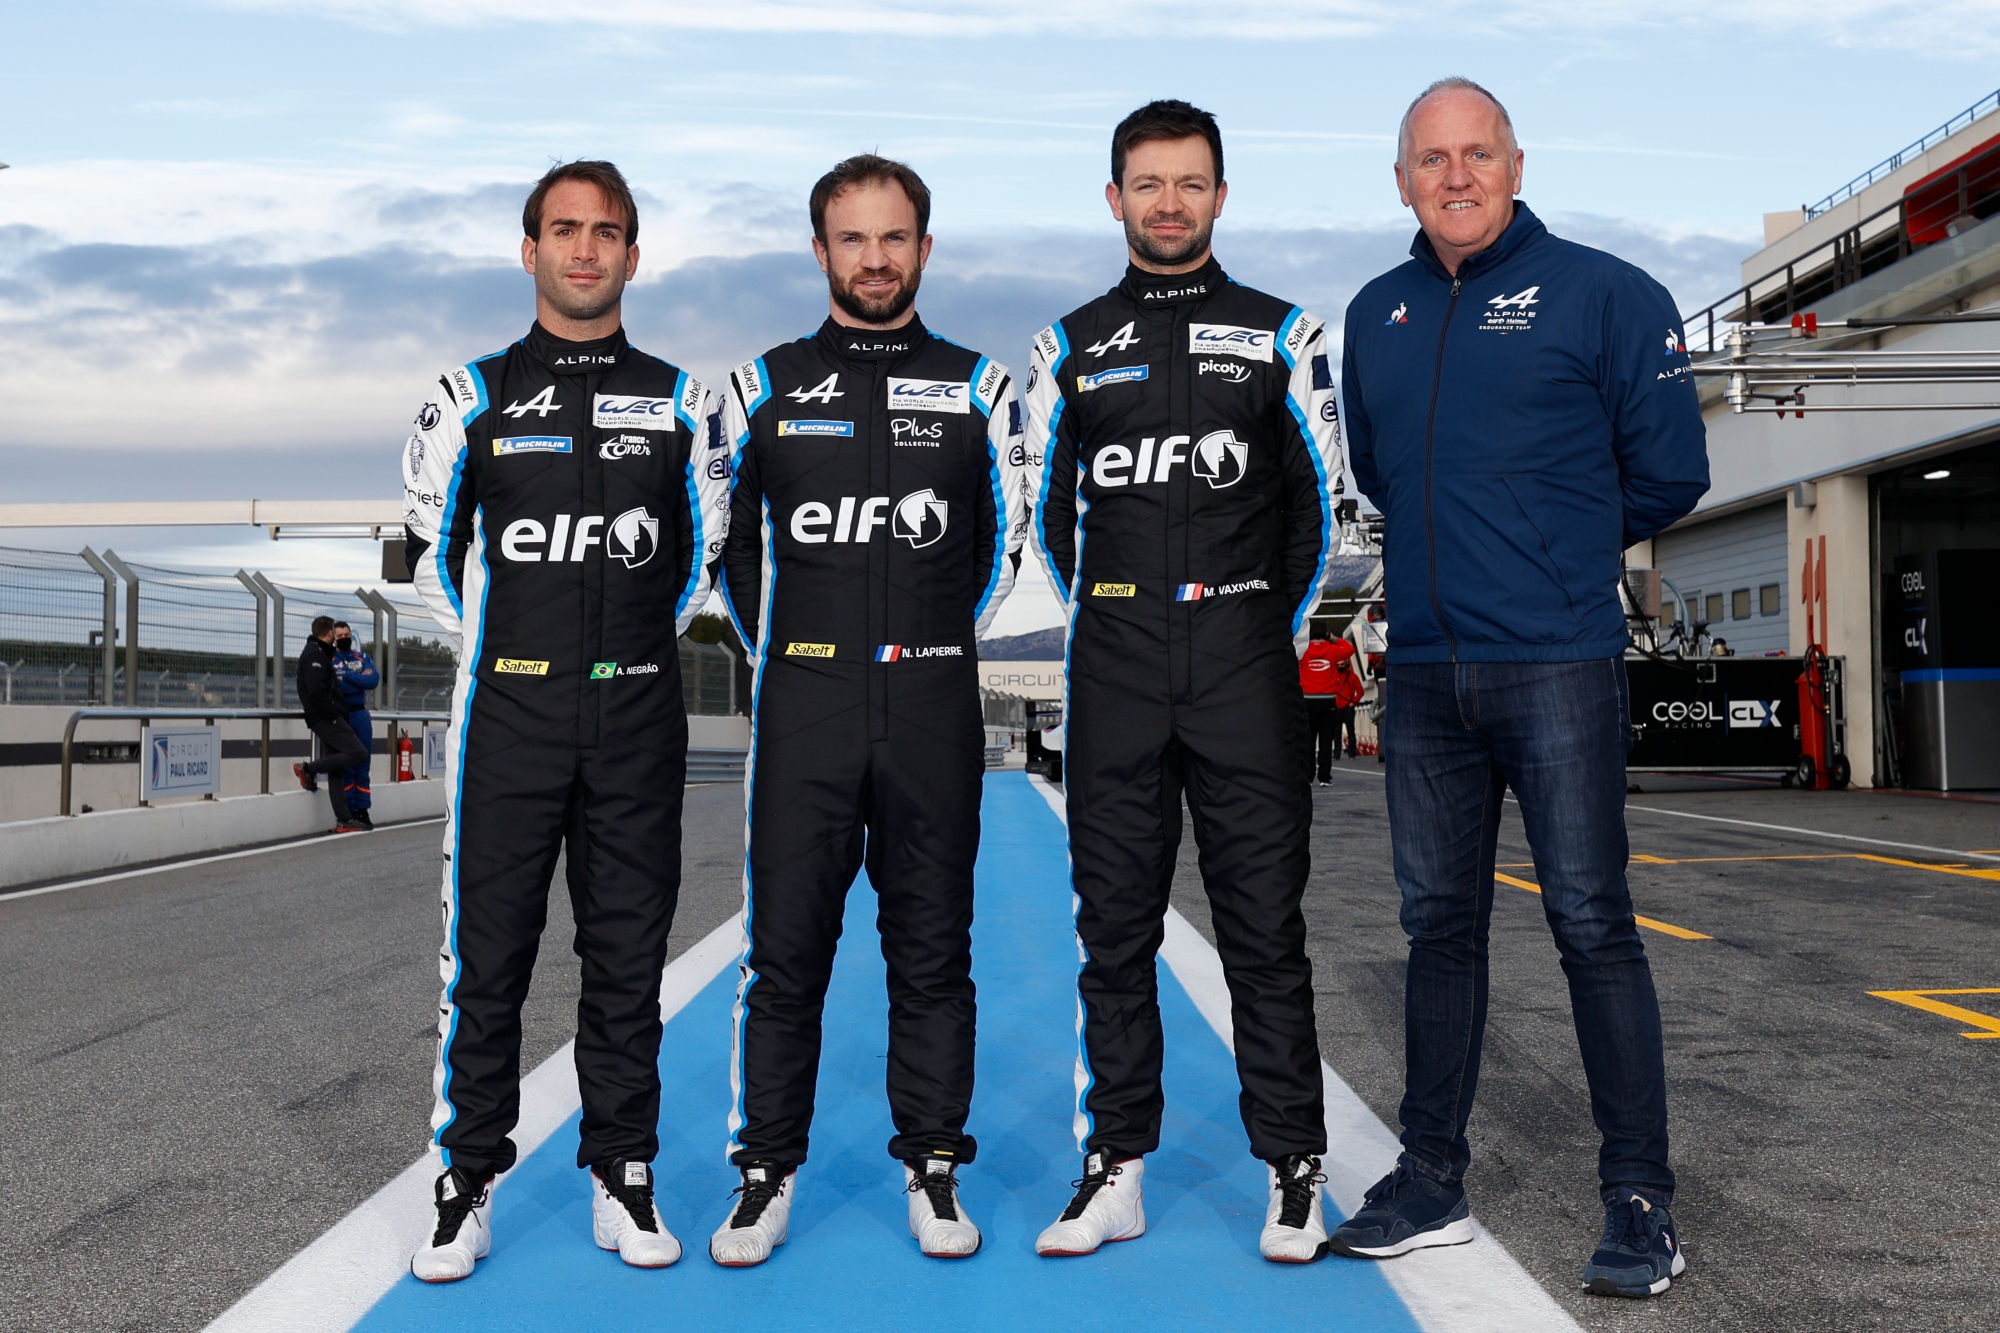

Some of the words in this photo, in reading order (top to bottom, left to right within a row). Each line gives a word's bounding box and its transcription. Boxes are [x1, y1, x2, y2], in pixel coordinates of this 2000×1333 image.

[1144, 285, 1206, 299] ALPINE
[1195, 329, 1269, 346] WEC
[1287, 317, 1310, 350] Sabelt
[1040, 328, 1057, 355] Sabelt
[1228, 344, 1263, 353] ENDURANCE
[555, 355, 616, 365] ALPINE
[1199, 359, 1246, 379] picoty
[741, 362, 759, 393] Sabelt
[979, 365, 1001, 396] Sabelt
[1097, 370, 1142, 384] MICHELIN
[452, 370, 475, 402] Sabelt
[893, 383, 964, 398] WEC
[598, 400, 669, 415] WEC
[630, 416, 665, 424] ENDURANCE
[798, 424, 847, 432] MICHELIN
[890, 417, 943, 441] Plus
[620, 433, 646, 444] France
[599, 436, 651, 460] toner
[1093, 435, 1190, 487] elf
[790, 497, 890, 543] elf
[501, 514, 604, 562] elf
[1901, 571, 1926, 592] COOL
[1097, 584, 1132, 596] Sabelt
[1203, 587, 1217, 597] M.
[791, 643, 830, 656] Sabelt
[902, 648, 913, 658] N.
[916, 645, 963, 658] LAPIERRE
[501, 659, 543, 673] Sabelt
[616, 666, 625, 676] A.
[626, 663, 659, 675] NEGRÃO
[1652, 701, 1723, 721] COOL
[1730, 700, 1782, 727] CLX
[170, 743, 208, 757] CIRCUIT
[170, 763, 186, 778] PAUL
[187, 761, 208, 776] RICARD
